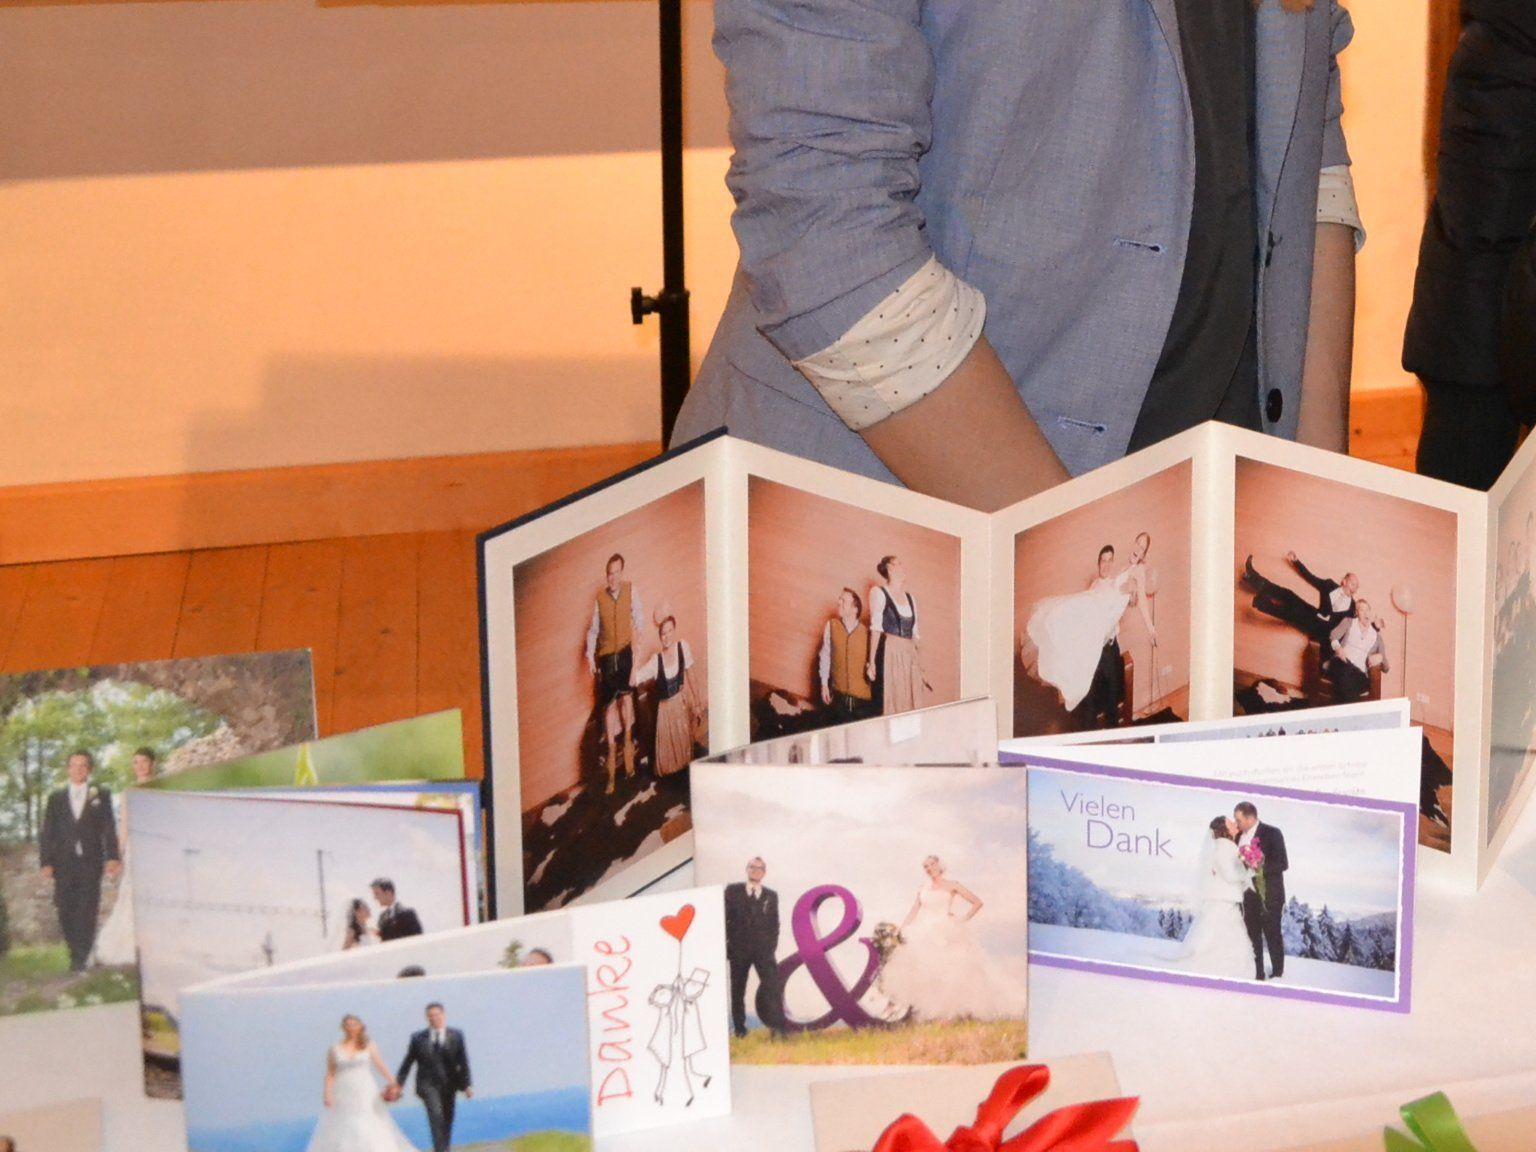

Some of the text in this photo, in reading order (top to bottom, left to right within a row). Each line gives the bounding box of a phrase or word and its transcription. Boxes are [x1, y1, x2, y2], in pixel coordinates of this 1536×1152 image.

[1060, 789, 1135, 821] Vielen
[1087, 819, 1173, 858] Dank
[586, 935, 633, 1107] Danke
